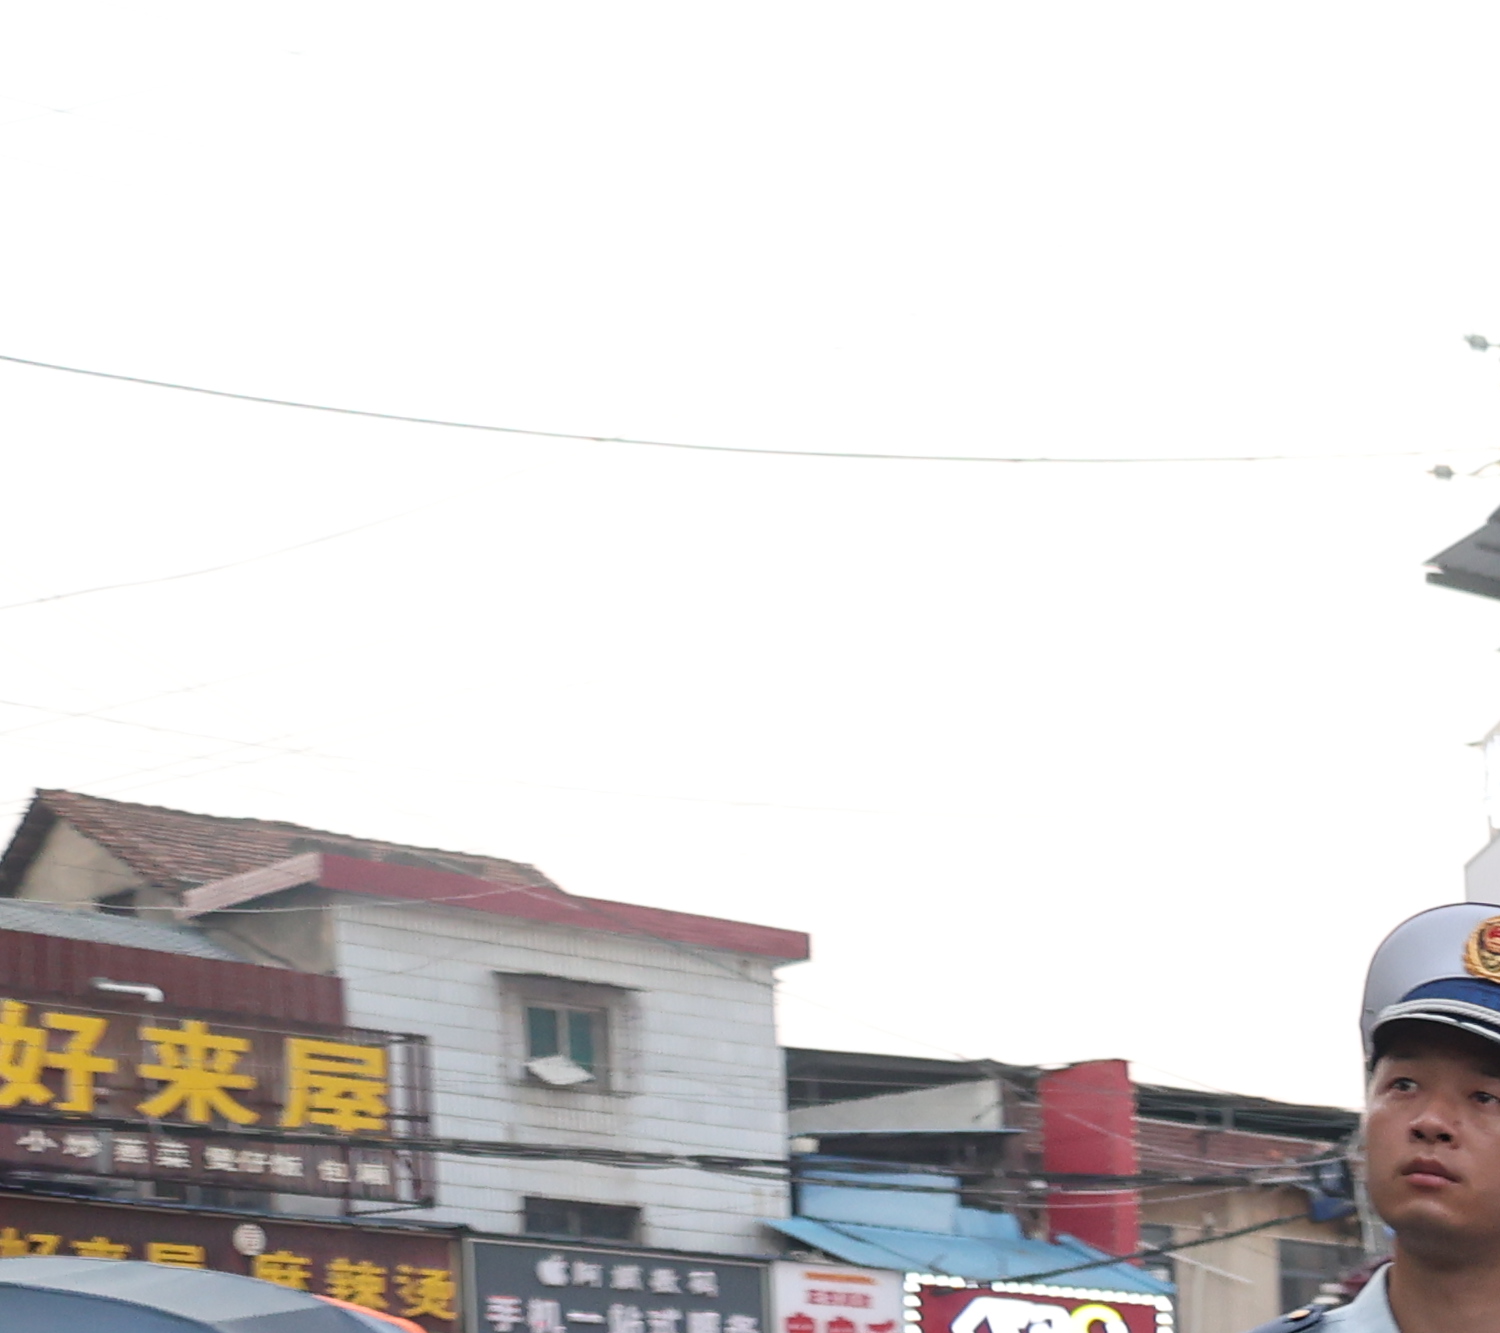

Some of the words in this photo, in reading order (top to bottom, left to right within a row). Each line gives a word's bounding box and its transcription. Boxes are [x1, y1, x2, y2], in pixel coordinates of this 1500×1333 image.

[0, 1002, 392, 1133] 好来屋
[252, 1249, 458, 1322] 麻辣烫
